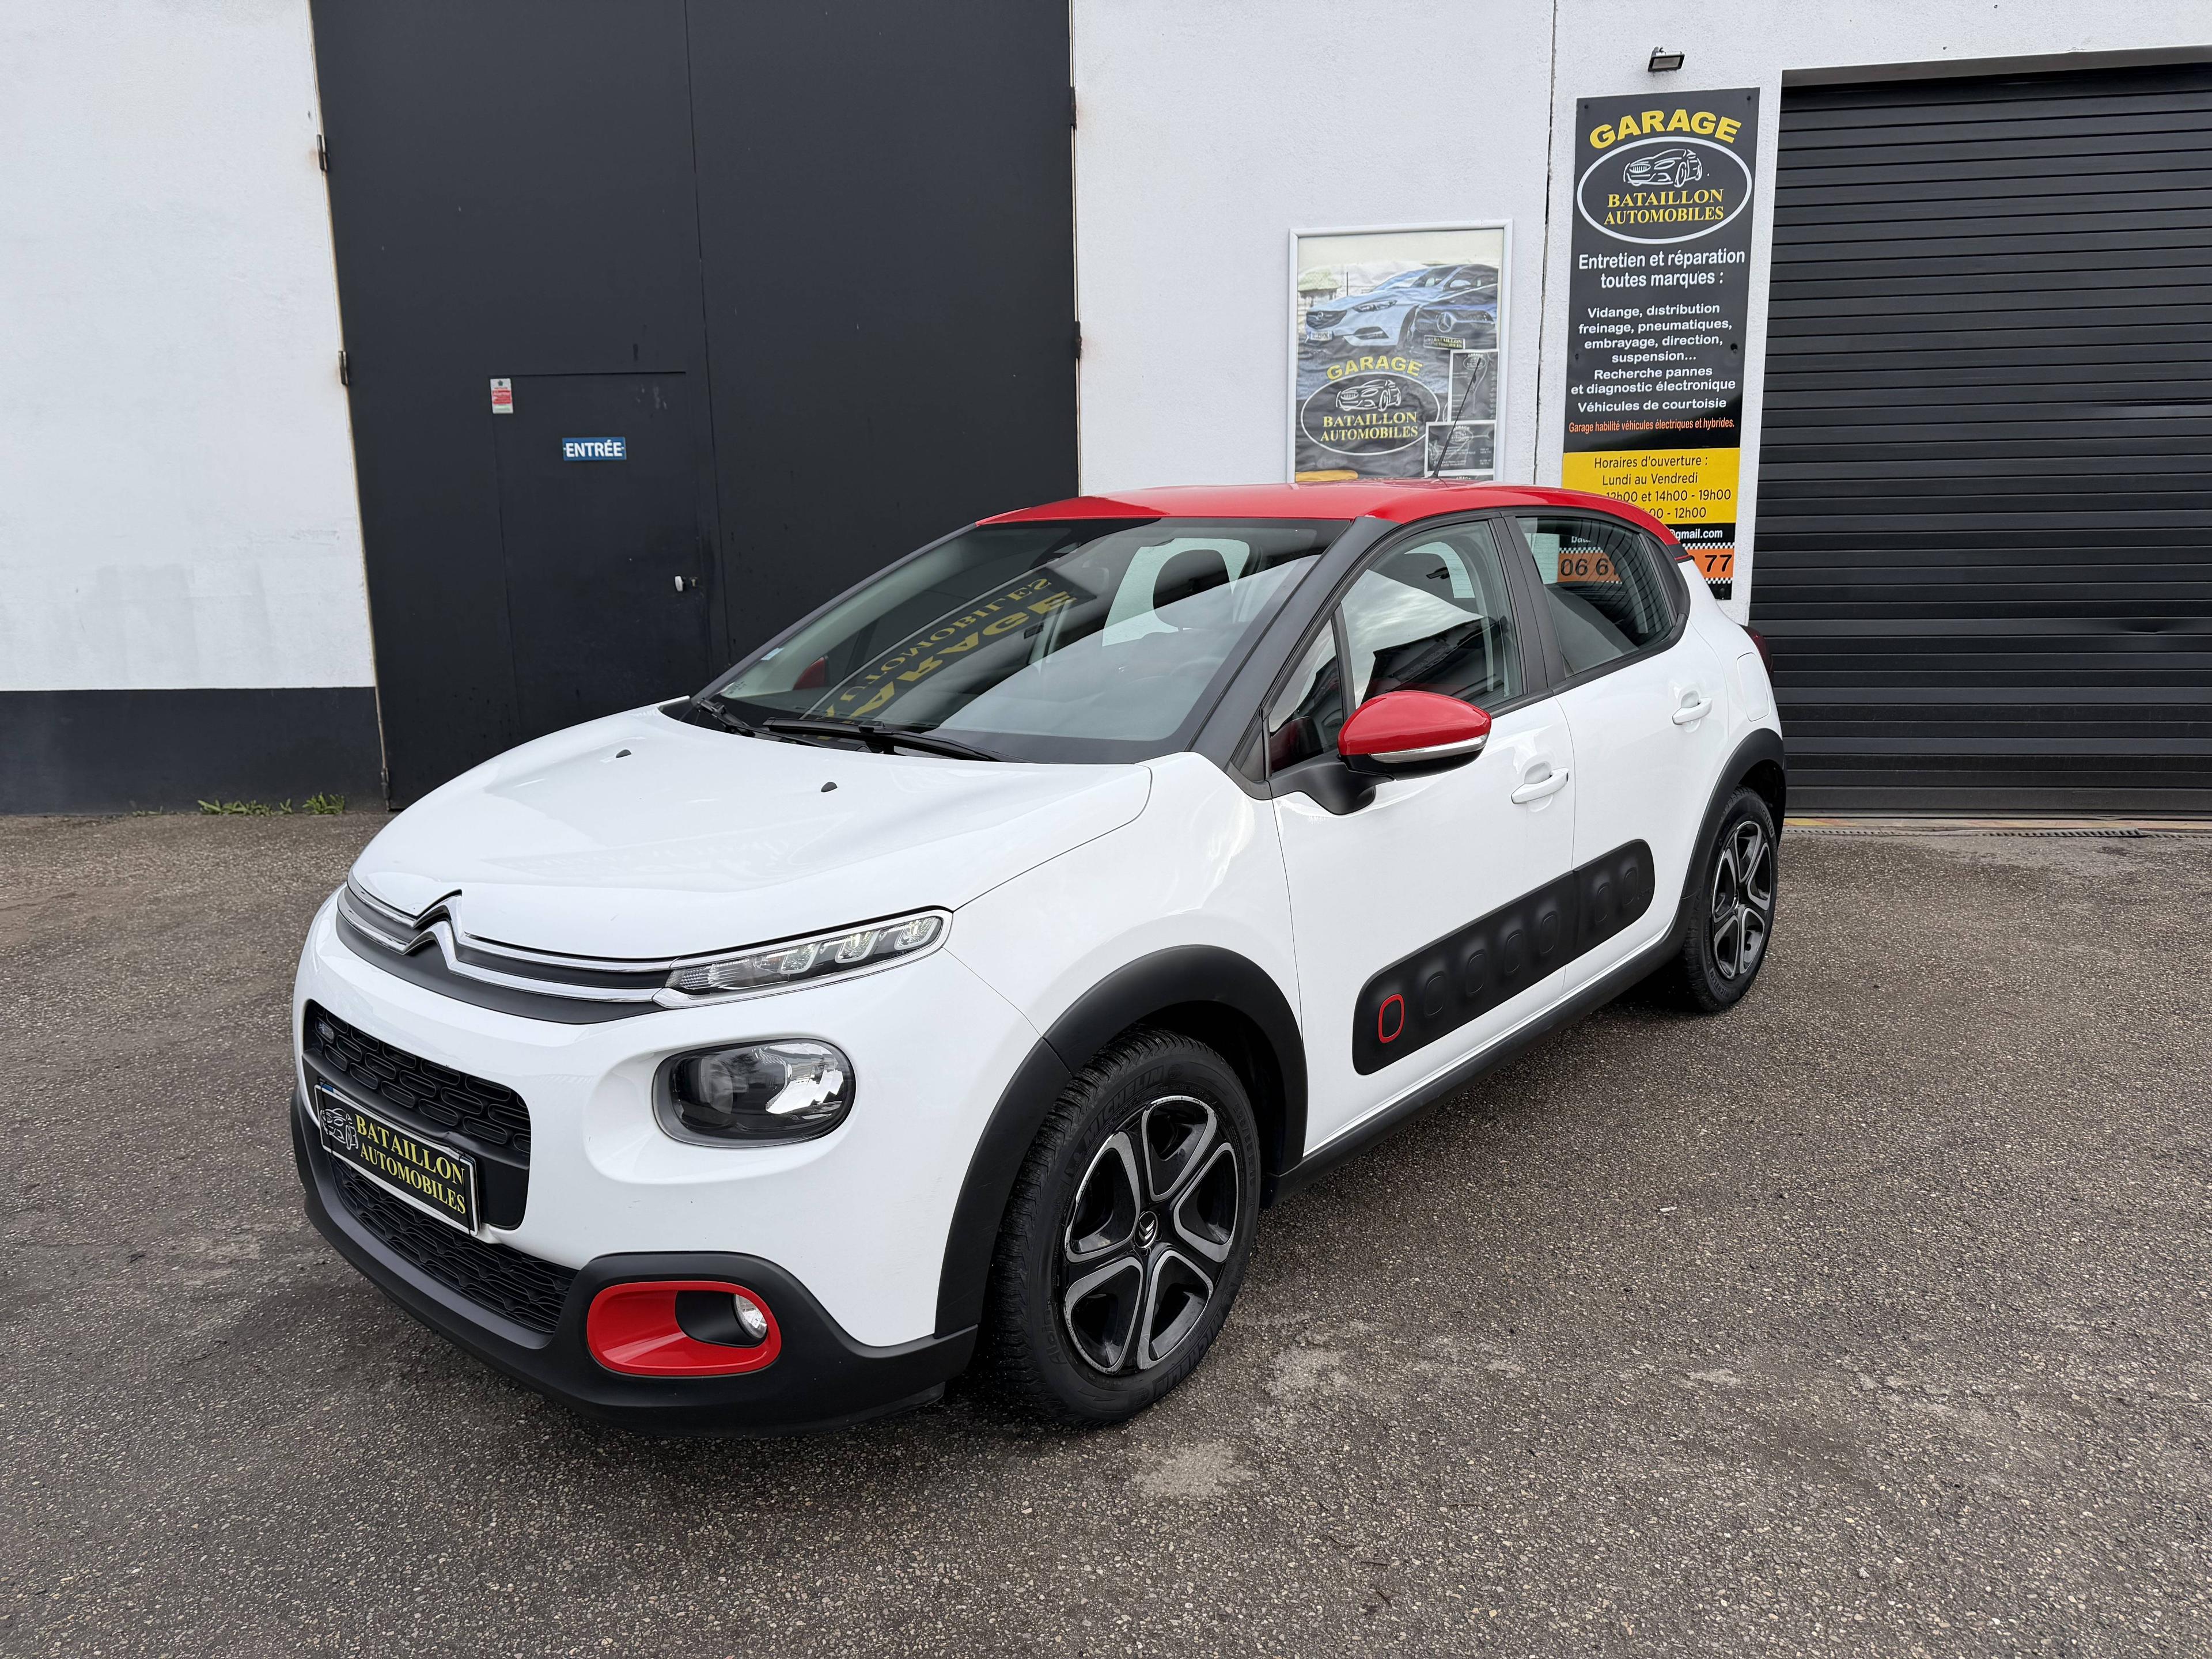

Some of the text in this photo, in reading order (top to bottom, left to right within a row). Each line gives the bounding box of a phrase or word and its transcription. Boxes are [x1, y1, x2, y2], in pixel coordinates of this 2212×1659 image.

[1590, 109, 1741, 149] GARAGE
[1607, 189, 1724, 207] BATAILLON
[1604, 206, 1724, 225] AUTOMOBILES
[1579, 248, 1745, 269] Entretien et réparation
[1601, 272, 1646, 288] toutes
[1651, 271, 1715, 288] marques
[1588, 304, 1720, 319] Vidange, distribution
[1579, 319, 1732, 335] freinage, pneumatiques,
[1585, 335, 1723, 350] embrayage, direction,
[1612, 351, 1696, 364] suspension...
[1327, 355, 1423, 380] GARAGE
[1594, 367, 1713, 380] Recherche pannes
[1571, 379, 1736, 396] et diagnostic électronique
[1578, 397, 1727, 412] Véhicules de courtoisie
[1323, 411, 1417, 428] BATAILLON
[1569, 416, 1734, 434] Garage habilité véhicules électriques et hybrides.
[1320, 426, 1418, 442] AUTOMOBILES
[566, 439, 623, 457] ENTRÉE
[1594, 457, 1637, 469] Horaires
[1602, 472, 1698, 486] Lundi au Vendredi
[1642, 491, 1652, 502] et
[1656, 490, 1688, 502] 14h00
[1699, 488, 1731, 501] 19h00
[1675, 507, 1707, 518] 12h00
[1560, 558, 1588, 576] 06
[1705, 554, 1732, 572] 77
[1082, 1065, 1164, 1144] MICHELIN
[355, 1113, 465, 1186] BATAILLON
[360, 1143, 466, 1214] AUTOMOBILES
